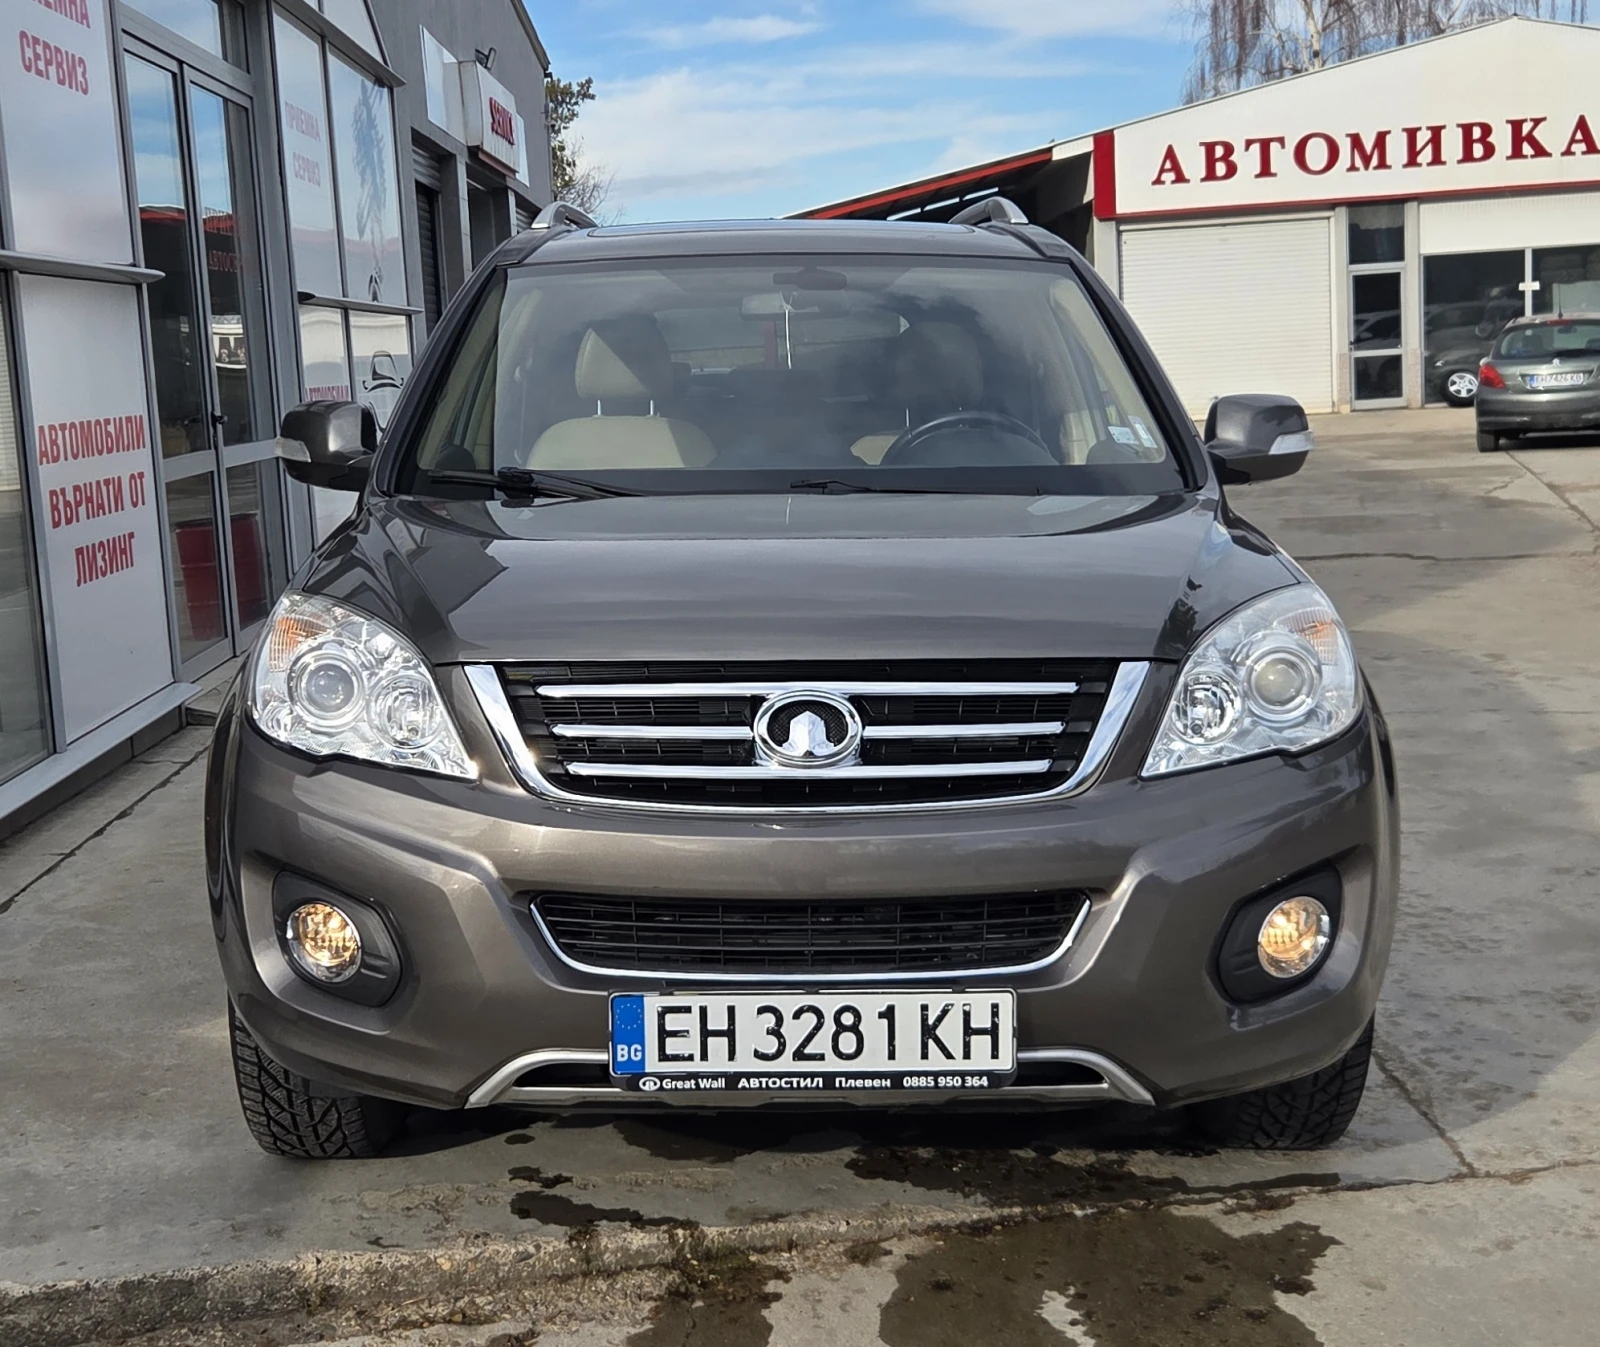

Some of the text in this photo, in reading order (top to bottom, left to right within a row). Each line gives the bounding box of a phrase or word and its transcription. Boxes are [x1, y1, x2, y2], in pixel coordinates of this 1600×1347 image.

[19, 30, 89, 95] СЕРВИЗ
[1151, 114, 1600, 186] АВТОМИВКА
[38, 415, 146, 465] АВТОМОБИЛИ
[49, 471, 146, 529] ВЪРНАТИ ОТ
[74, 531, 135, 588] ЛИЗИНГ
[616, 1044, 642, 1062] BG
[657, 1003, 1000, 1062] EH 3281 KH
[662, 1077, 726, 1090] Great Wall
[738, 1075, 989, 1089] АВТОСТИЛ Плевен 0885 950 364
